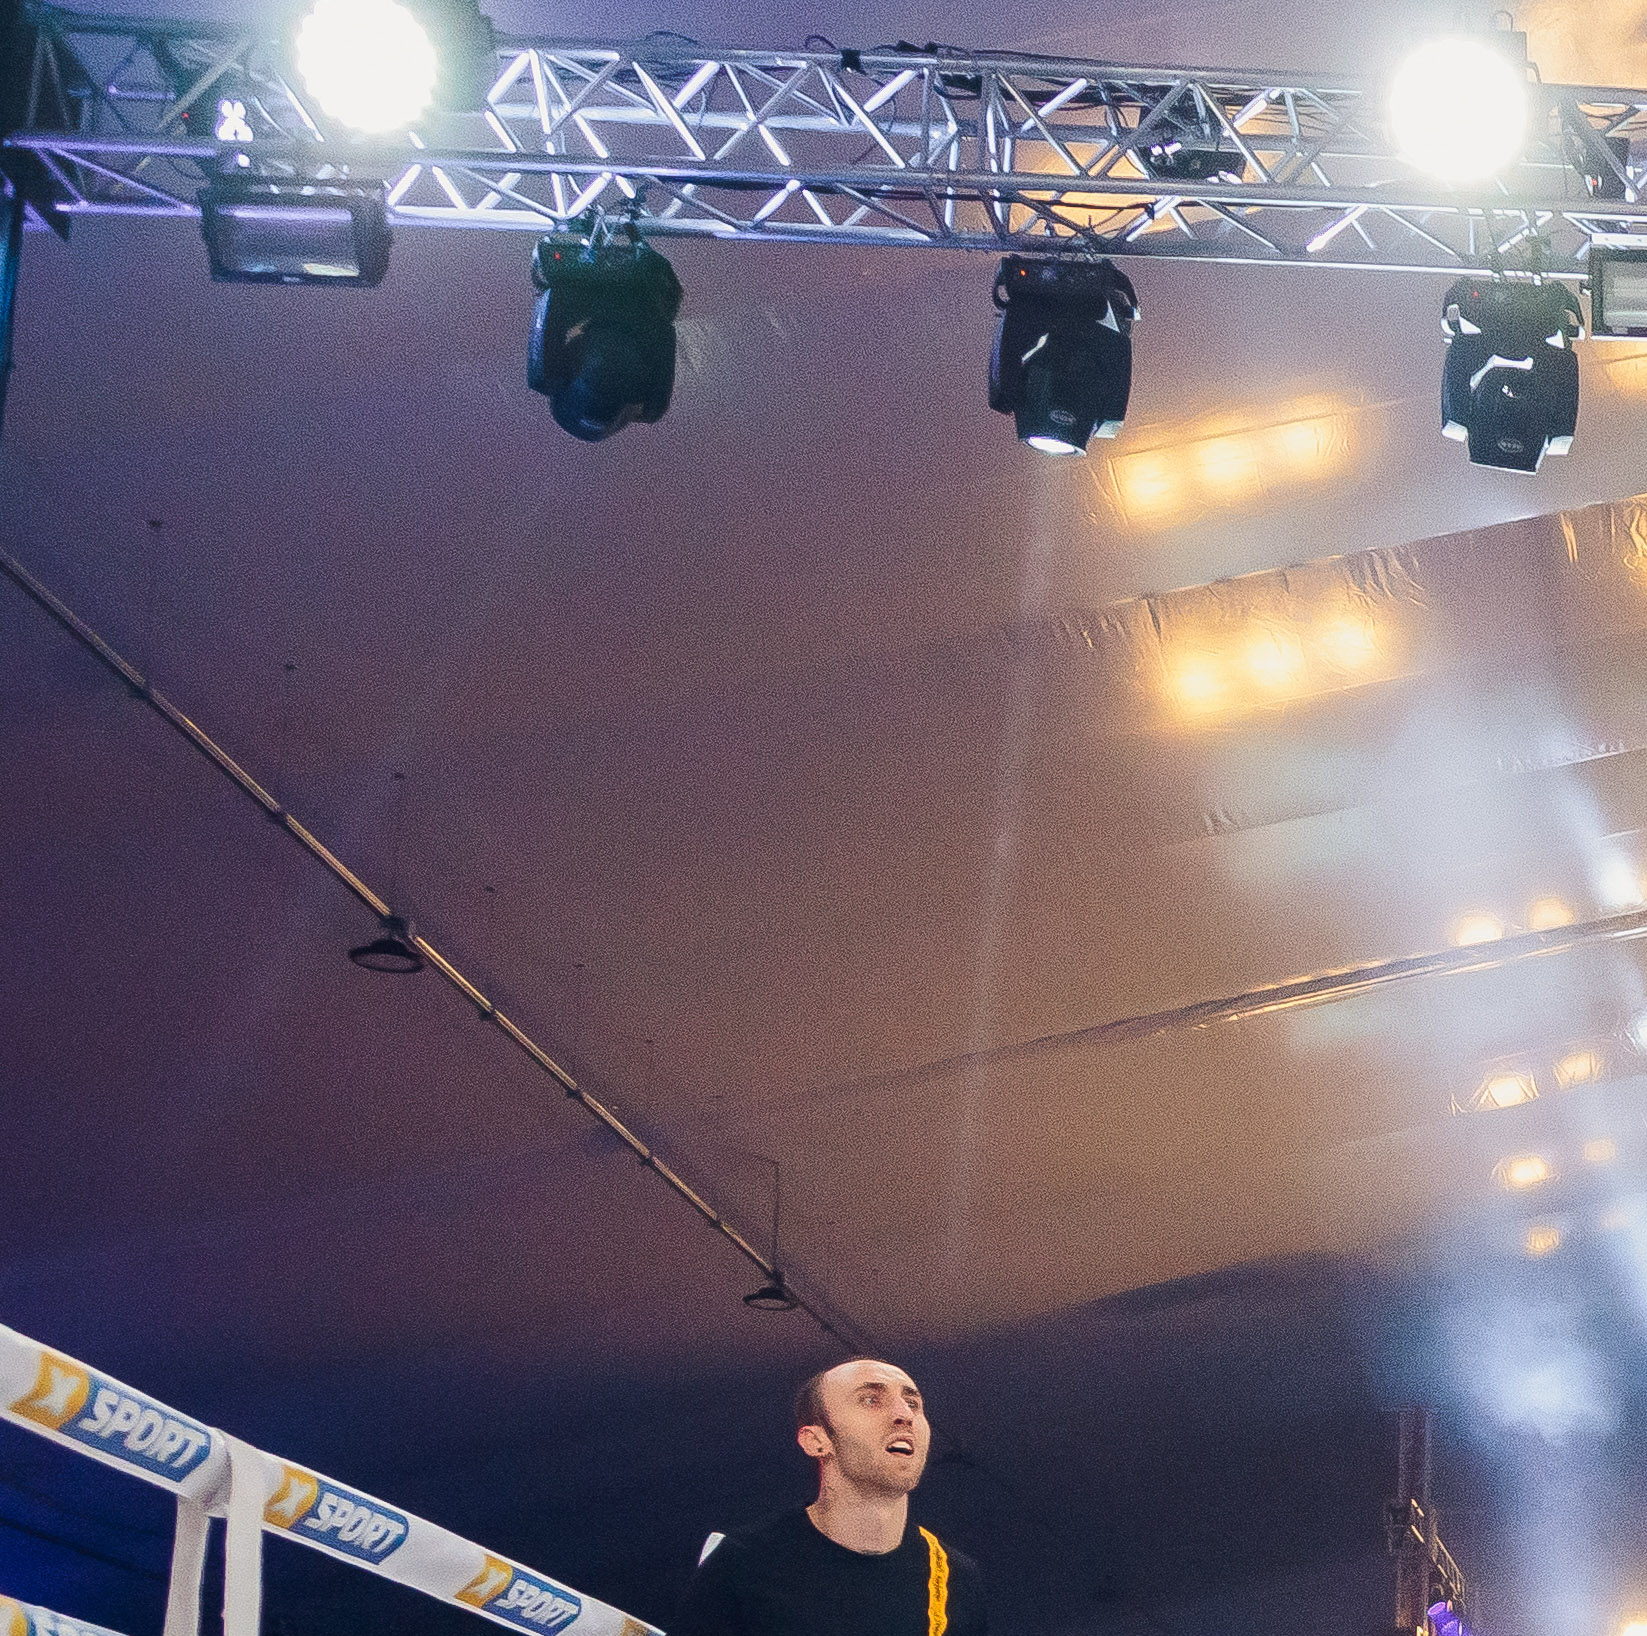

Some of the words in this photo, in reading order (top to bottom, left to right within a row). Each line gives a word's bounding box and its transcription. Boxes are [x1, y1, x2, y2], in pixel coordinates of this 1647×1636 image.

[81, 1389, 207, 1469] SPORT
[305, 1492, 403, 1552] SPORT
[499, 1581, 580, 1630] SPORT
